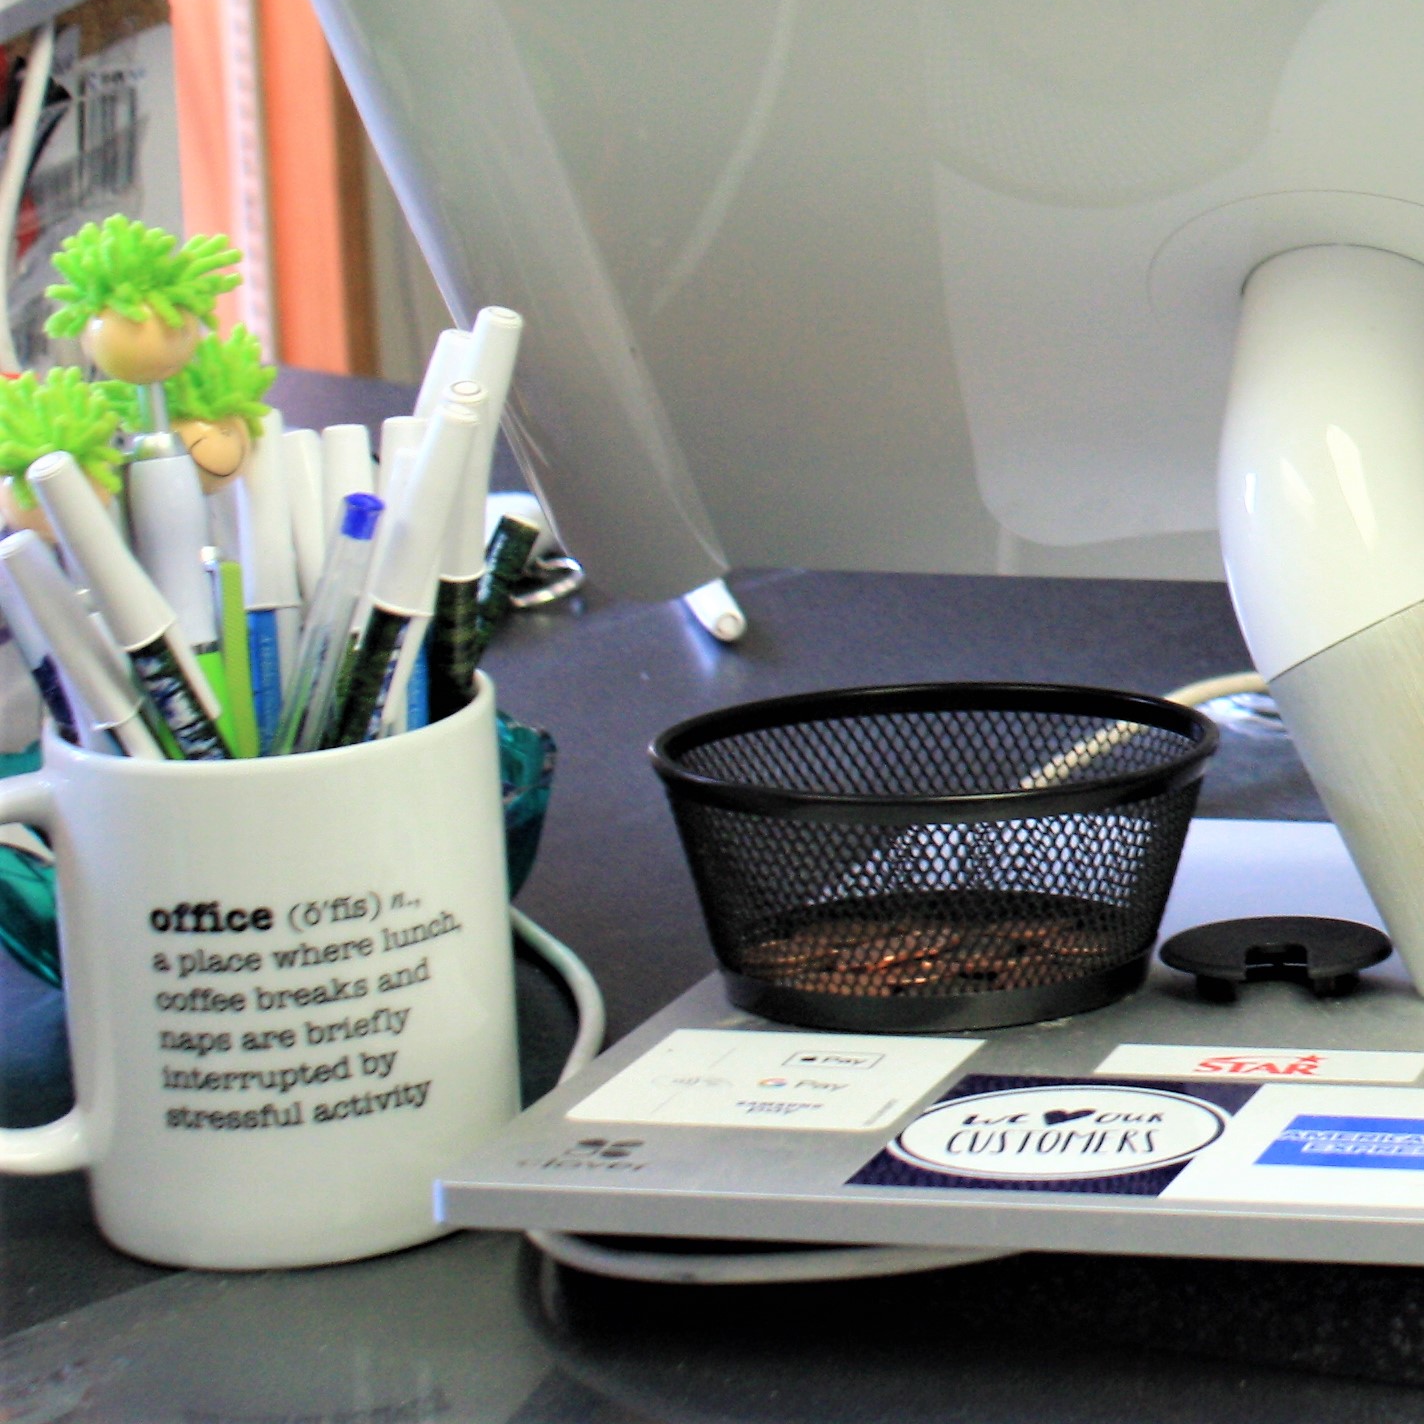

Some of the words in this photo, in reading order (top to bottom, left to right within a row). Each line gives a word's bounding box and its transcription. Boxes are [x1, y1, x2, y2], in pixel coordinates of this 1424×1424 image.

[150, 901, 274, 932] office
[153, 952, 170, 972] a
[179, 949, 262, 977] place
[272, 937, 374, 969] where
[155, 987, 246, 1012] coffee
[256, 978, 369, 1011] breaks
[378, 958, 431, 993] and
[160, 1030, 232, 1056] naps
[241, 1029, 296, 1051] are
[305, 1007, 412, 1046] briefly
[162, 1056, 352, 1092] interrupted
[361, 1050, 398, 1078] by
[1193, 1058, 1321, 1075] STAR
[165, 1102, 304, 1130] stressful
[312, 1079, 433, 1124] activity
[946, 1129, 1158, 1155] CUSTOMERS
